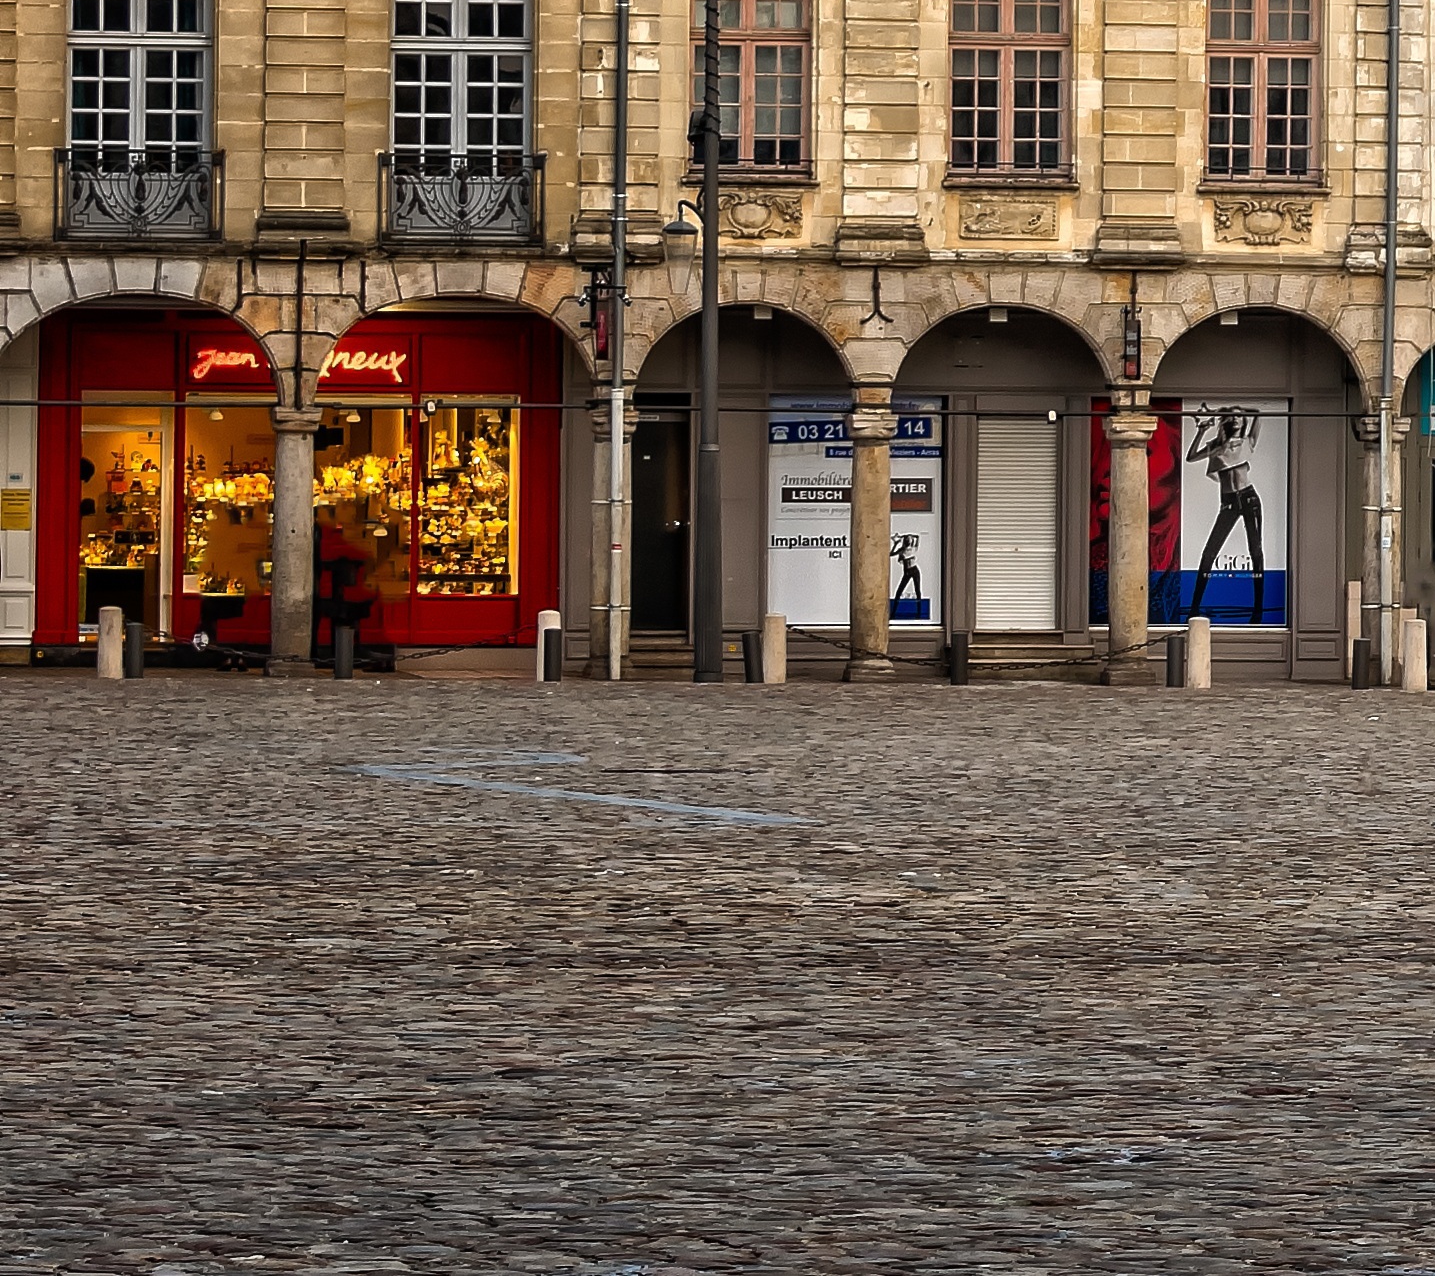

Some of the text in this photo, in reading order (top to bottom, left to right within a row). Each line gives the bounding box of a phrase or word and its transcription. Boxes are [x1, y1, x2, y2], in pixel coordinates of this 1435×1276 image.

[193, 348, 259, 380] Jean
[798, 420, 926, 440] 03 21 14
[890, 483, 927, 493] RTIER
[791, 490, 843, 500] LEUSCH
[771, 535, 848, 549] Implantent
[828, 550, 843, 559] ICI
